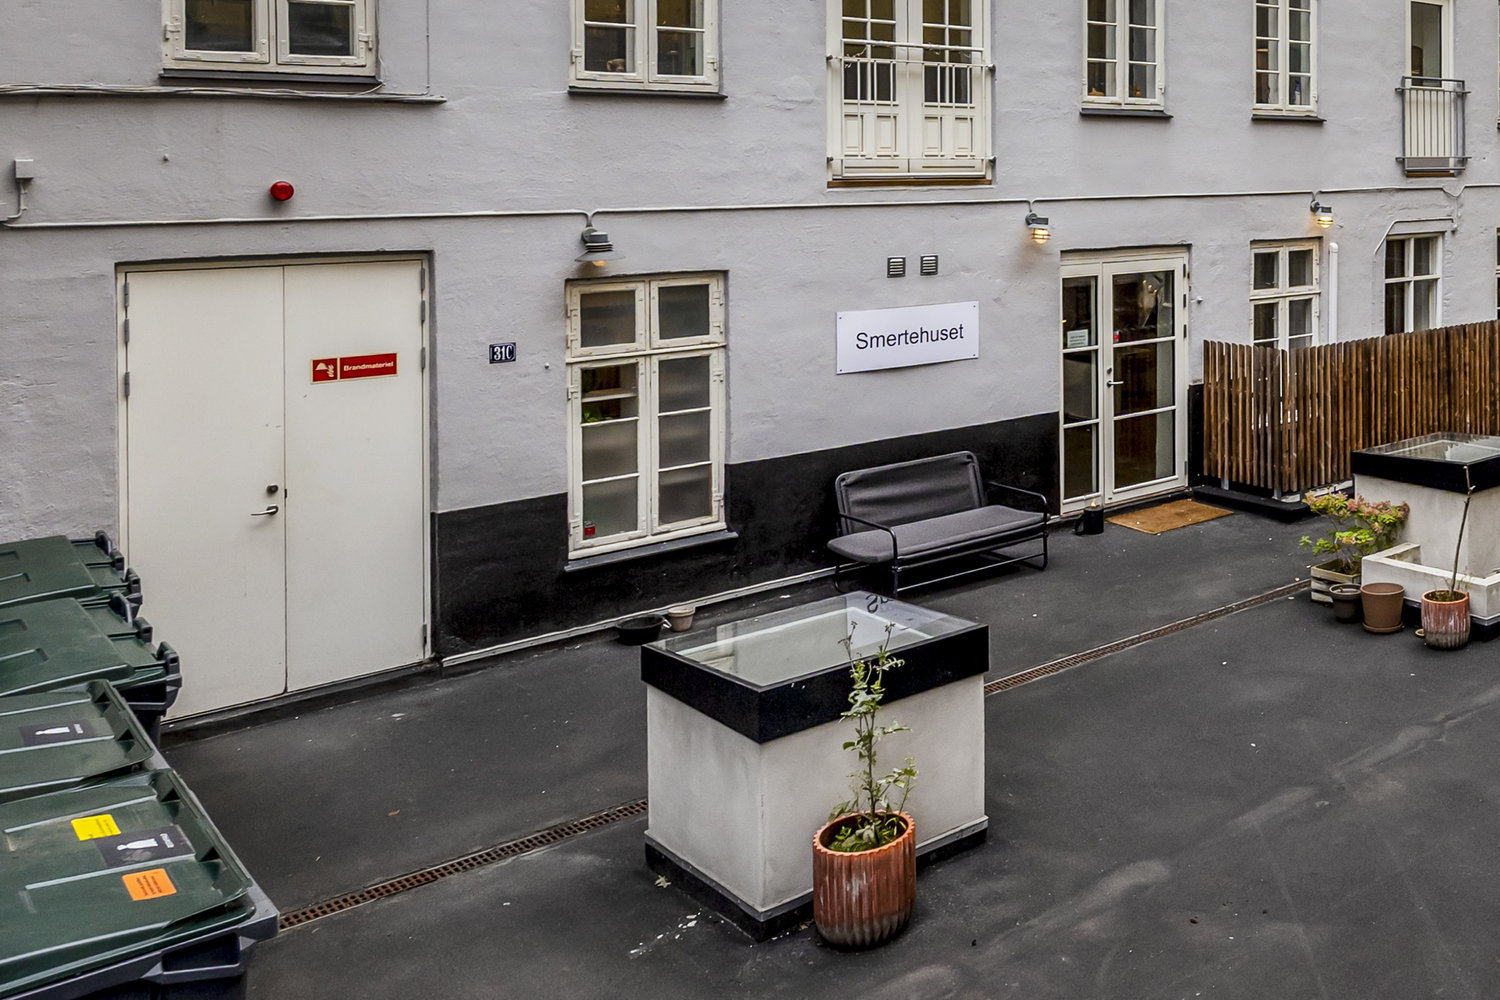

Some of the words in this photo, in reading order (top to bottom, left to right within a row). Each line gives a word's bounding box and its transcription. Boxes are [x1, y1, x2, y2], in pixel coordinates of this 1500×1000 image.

[856, 324, 964, 349] Smertehuset
[494, 345, 514, 360] 31C
[343, 361, 394, 371] Brandmateriel
